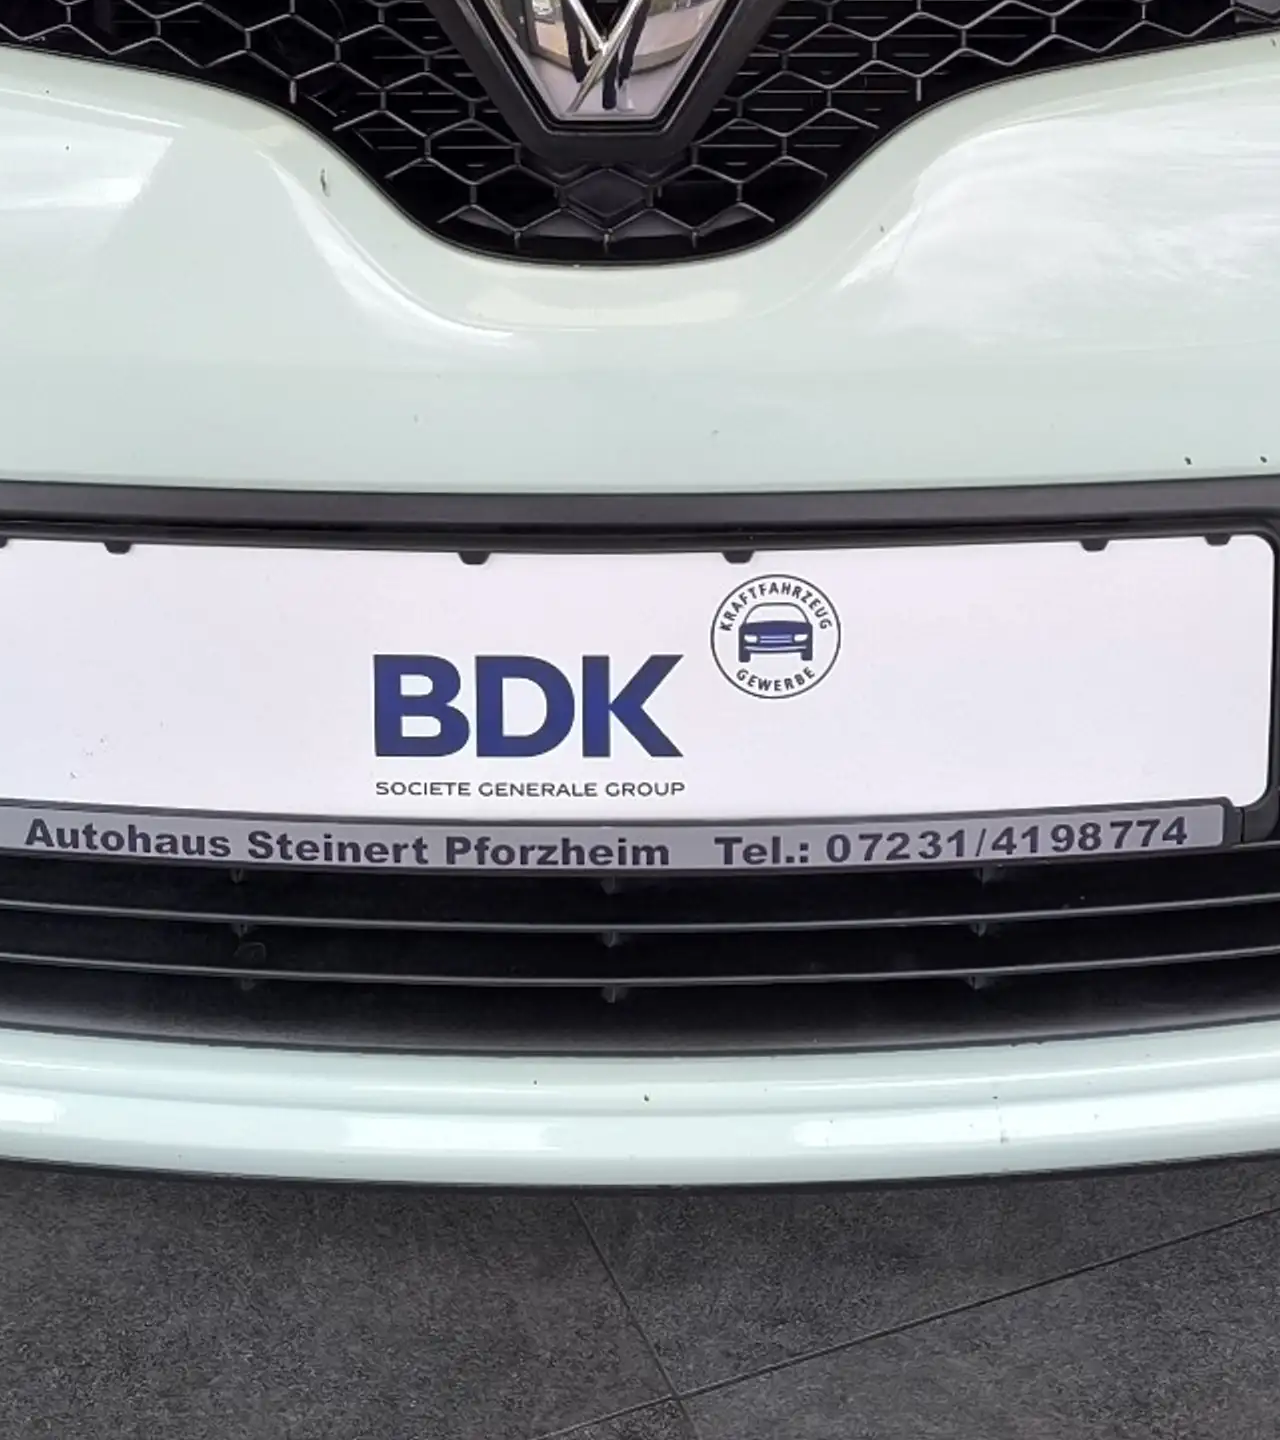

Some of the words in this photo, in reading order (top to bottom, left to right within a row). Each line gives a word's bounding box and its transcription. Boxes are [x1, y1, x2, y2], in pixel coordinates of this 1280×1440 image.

[720, 581, 833, 632] KRAFTFAHRZEUG
[736, 665, 816, 692] GEWERBE
[373, 654, 684, 758] BDK
[375, 780, 471, 797] SOCIETE
[477, 781, 598, 798] GENERALE
[604, 781, 686, 797] GROUP
[24, 817, 232, 858] Autohaus
[247, 829, 429, 866] Steinert
[445, 835, 670, 867] Pforzheim
[713, 834, 811, 866] Tel.:
[825, 816, 1188, 863] 07231/4198774
